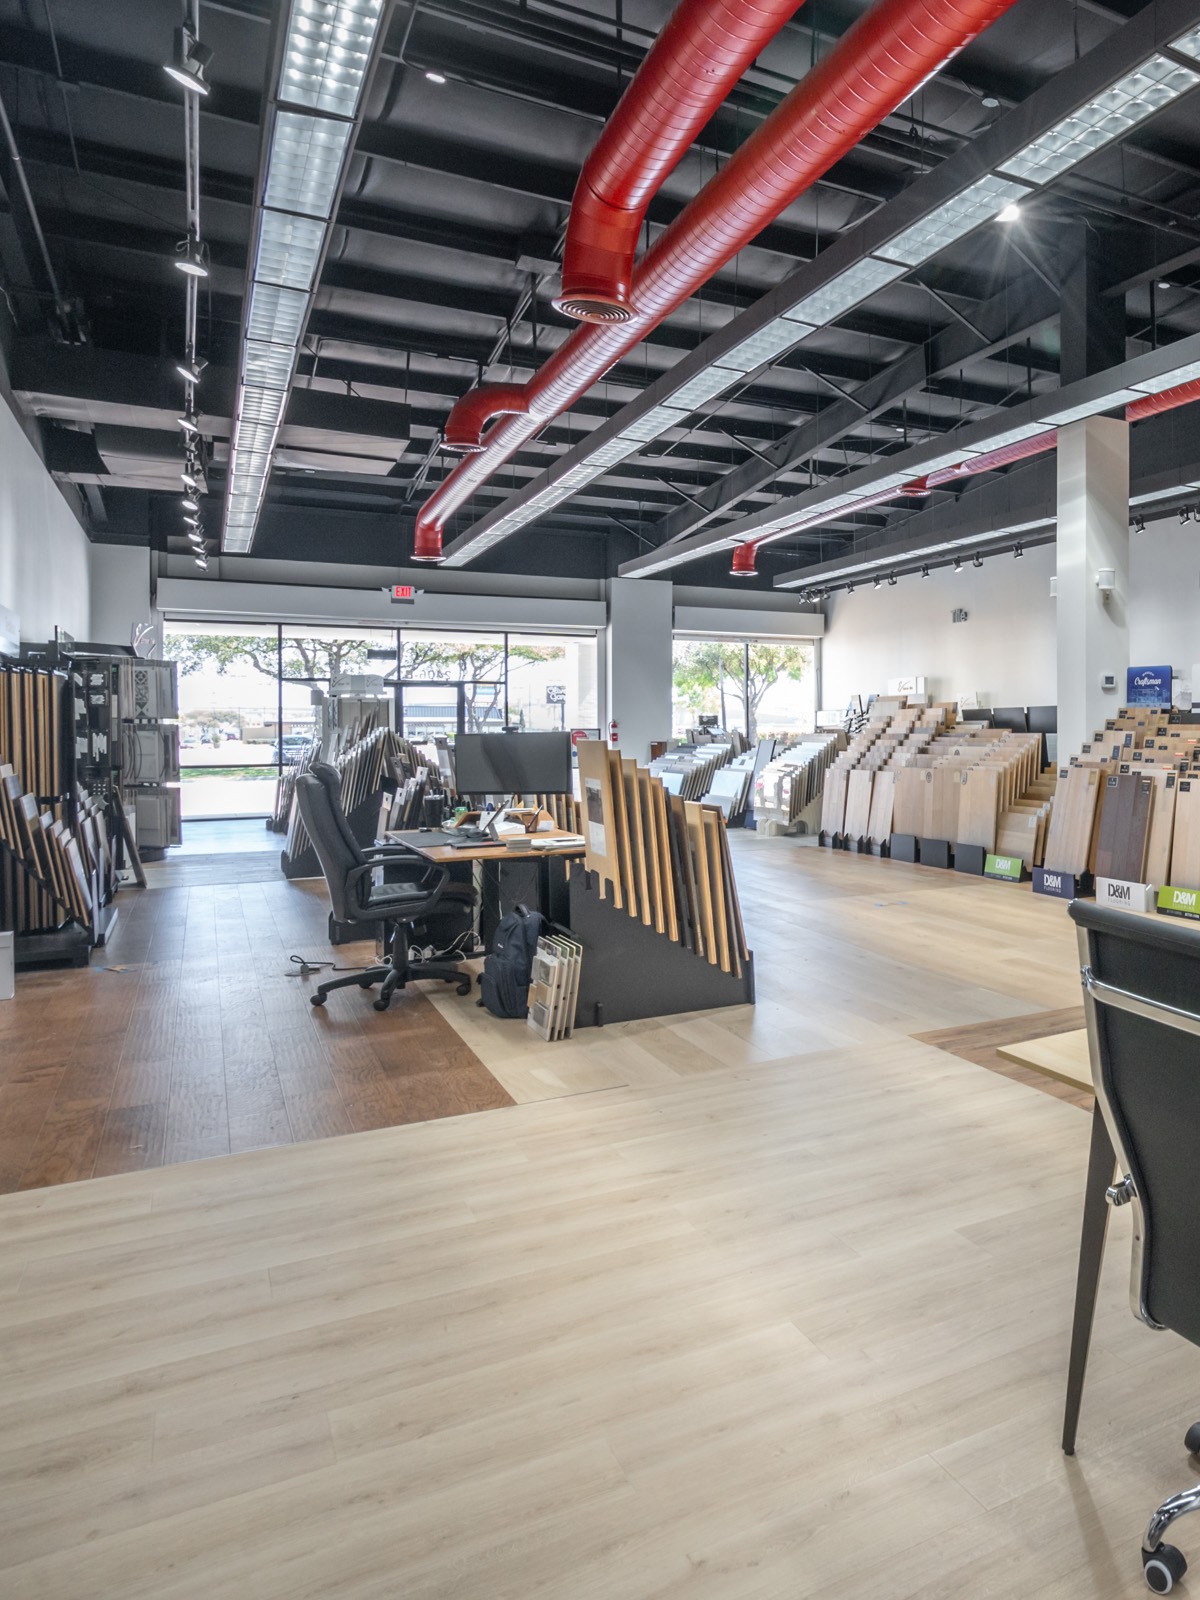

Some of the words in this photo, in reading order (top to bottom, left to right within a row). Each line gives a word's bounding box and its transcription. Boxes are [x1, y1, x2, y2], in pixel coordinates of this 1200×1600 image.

[395, 585, 412, 597] EXIT
[951, 608, 968, 623] Tile
[995, 858, 1011, 870] D&M
[1043, 874, 1062, 888] D&M
[1108, 883, 1131, 900] D&M
[1173, 891, 1197, 906] D&M
